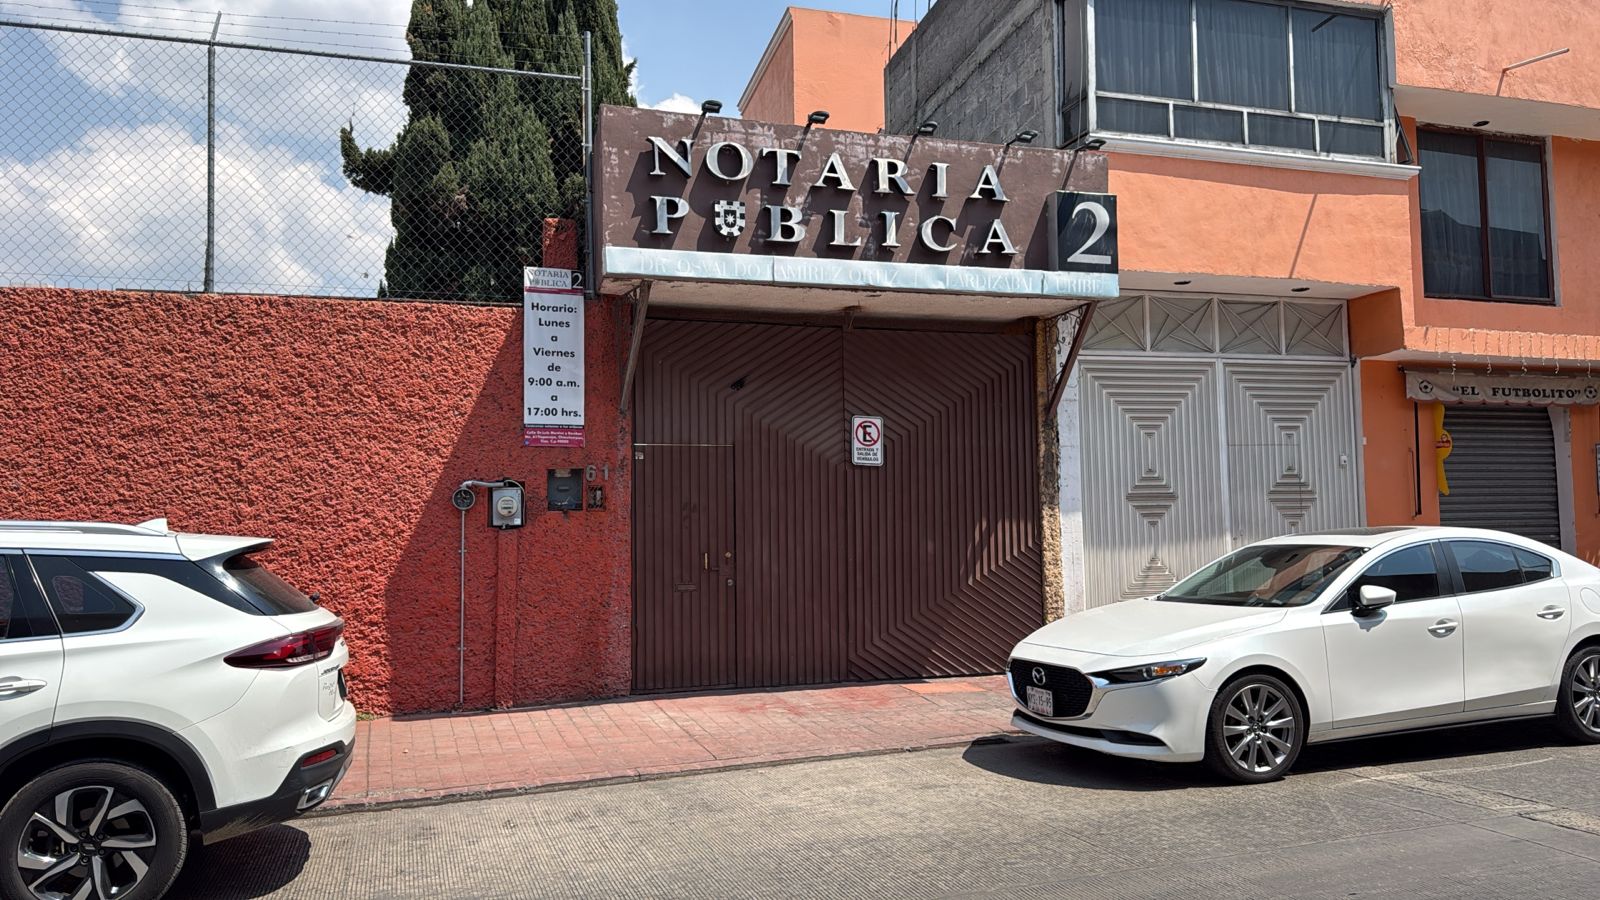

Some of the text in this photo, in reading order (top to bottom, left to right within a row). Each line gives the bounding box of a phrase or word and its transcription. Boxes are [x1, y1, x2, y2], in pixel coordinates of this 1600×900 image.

[646, 135, 1010, 203] NOTARIA
[650, 195, 1112, 265] PBLICA 2
[572, 272, 584, 288] 2
[531, 302, 577, 314] Horario:
[538, 317, 570, 328] Lunes
[533, 347, 576, 358] Viernes
[547, 363, 561, 372] de
[528, 377, 580, 388] 9:00 a.m.
[551, 394, 558, 402] a
[527, 407, 582, 418] 17:00 hrs.
[585, 464, 609, 481] 61
